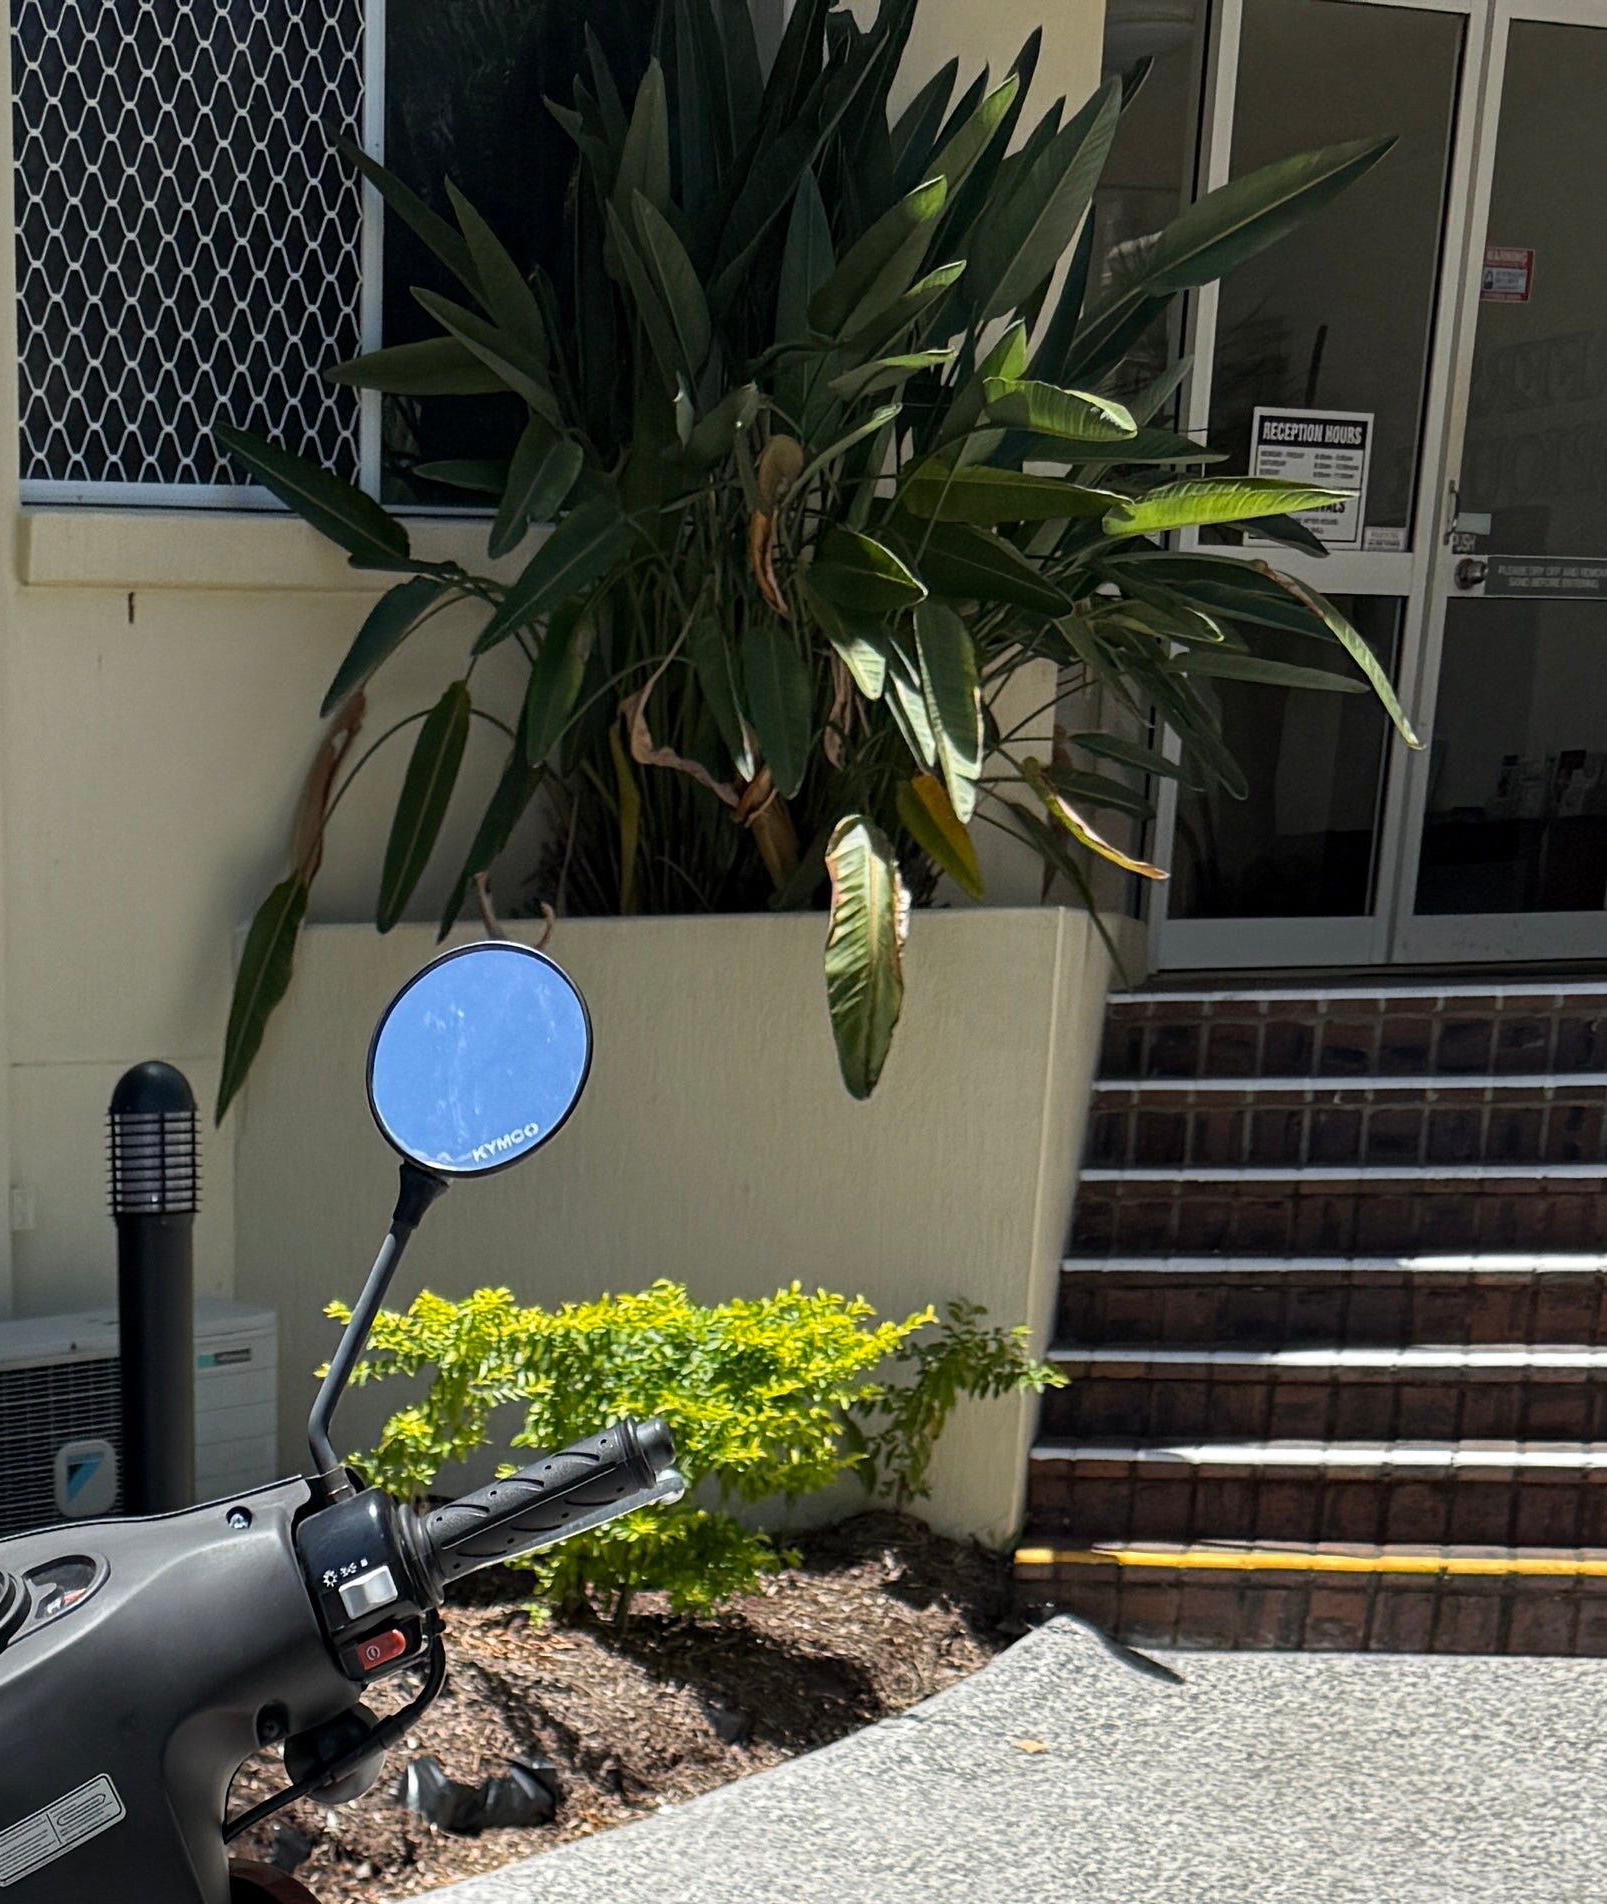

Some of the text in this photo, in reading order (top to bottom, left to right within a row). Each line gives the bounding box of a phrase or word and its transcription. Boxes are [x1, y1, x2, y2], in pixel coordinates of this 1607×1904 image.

[1262, 421, 1363, 445] RECEPTION HOURS
[472, 1122, 540, 1162] KYMCO
